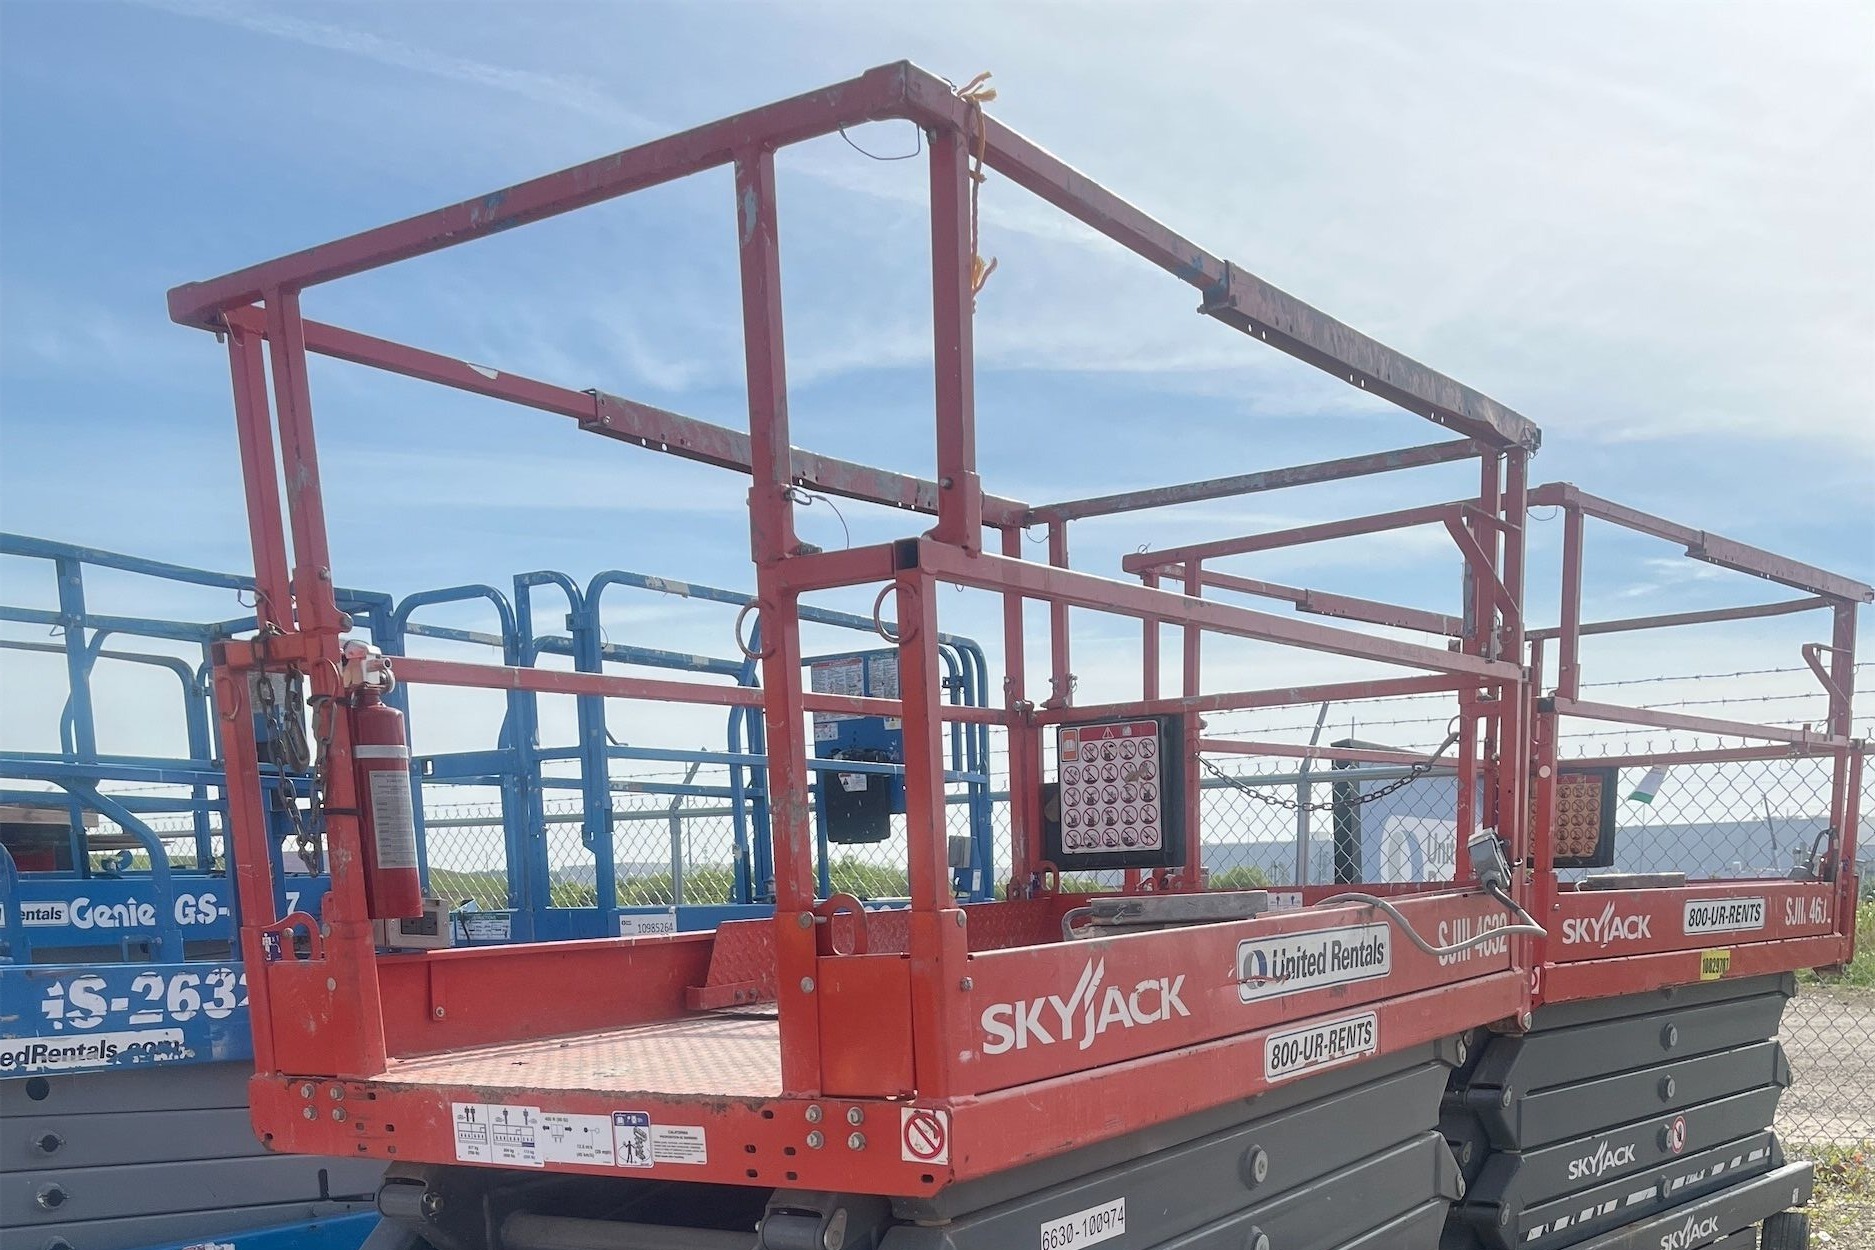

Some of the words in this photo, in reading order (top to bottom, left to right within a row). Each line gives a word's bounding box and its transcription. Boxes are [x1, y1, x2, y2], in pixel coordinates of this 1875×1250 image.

[21, 906, 62, 921] entals
[69, 896, 156, 929] Genie
[638, 922, 674, 934] 10985264
[1474, 912, 1508, 958] 4632
[1562, 900, 1652, 949] SKYJACK
[1688, 902, 1763, 928] 800-UR-RENTS
[1271, 942, 1327, 982] United
[1330, 930, 1386, 972] Rentals
[41, 967, 249, 1029] S-263
[980, 957, 1191, 1055] SKYJACK
[1269, 1021, 1375, 1072] 800-UR-RENTS
[1567, 1140, 1636, 1181] SKYJACK
